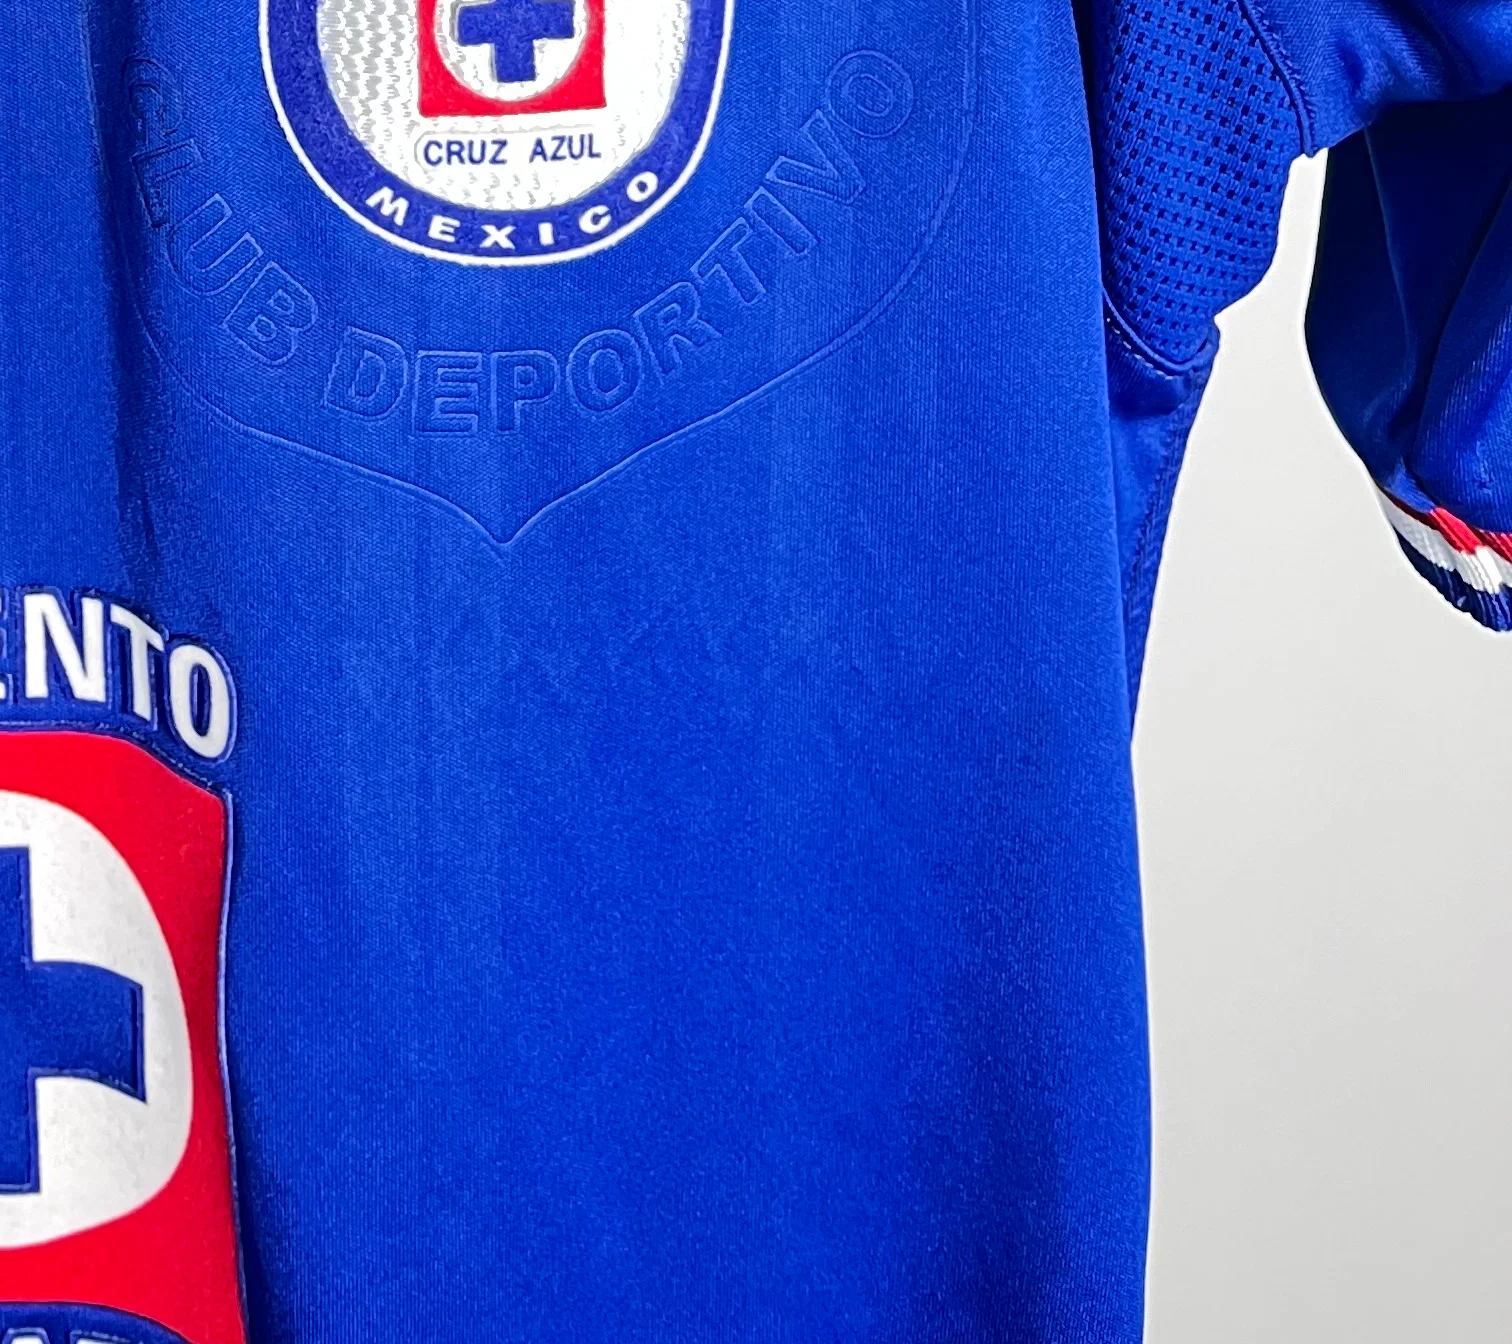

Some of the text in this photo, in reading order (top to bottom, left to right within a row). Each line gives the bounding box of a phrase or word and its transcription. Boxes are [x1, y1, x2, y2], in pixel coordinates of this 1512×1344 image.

[423, 133, 602, 166] CRUZ AZUL
[121, 49, 919, 436] CLUB DEPORTIVO
[364, 170, 660, 249] MEXICO
